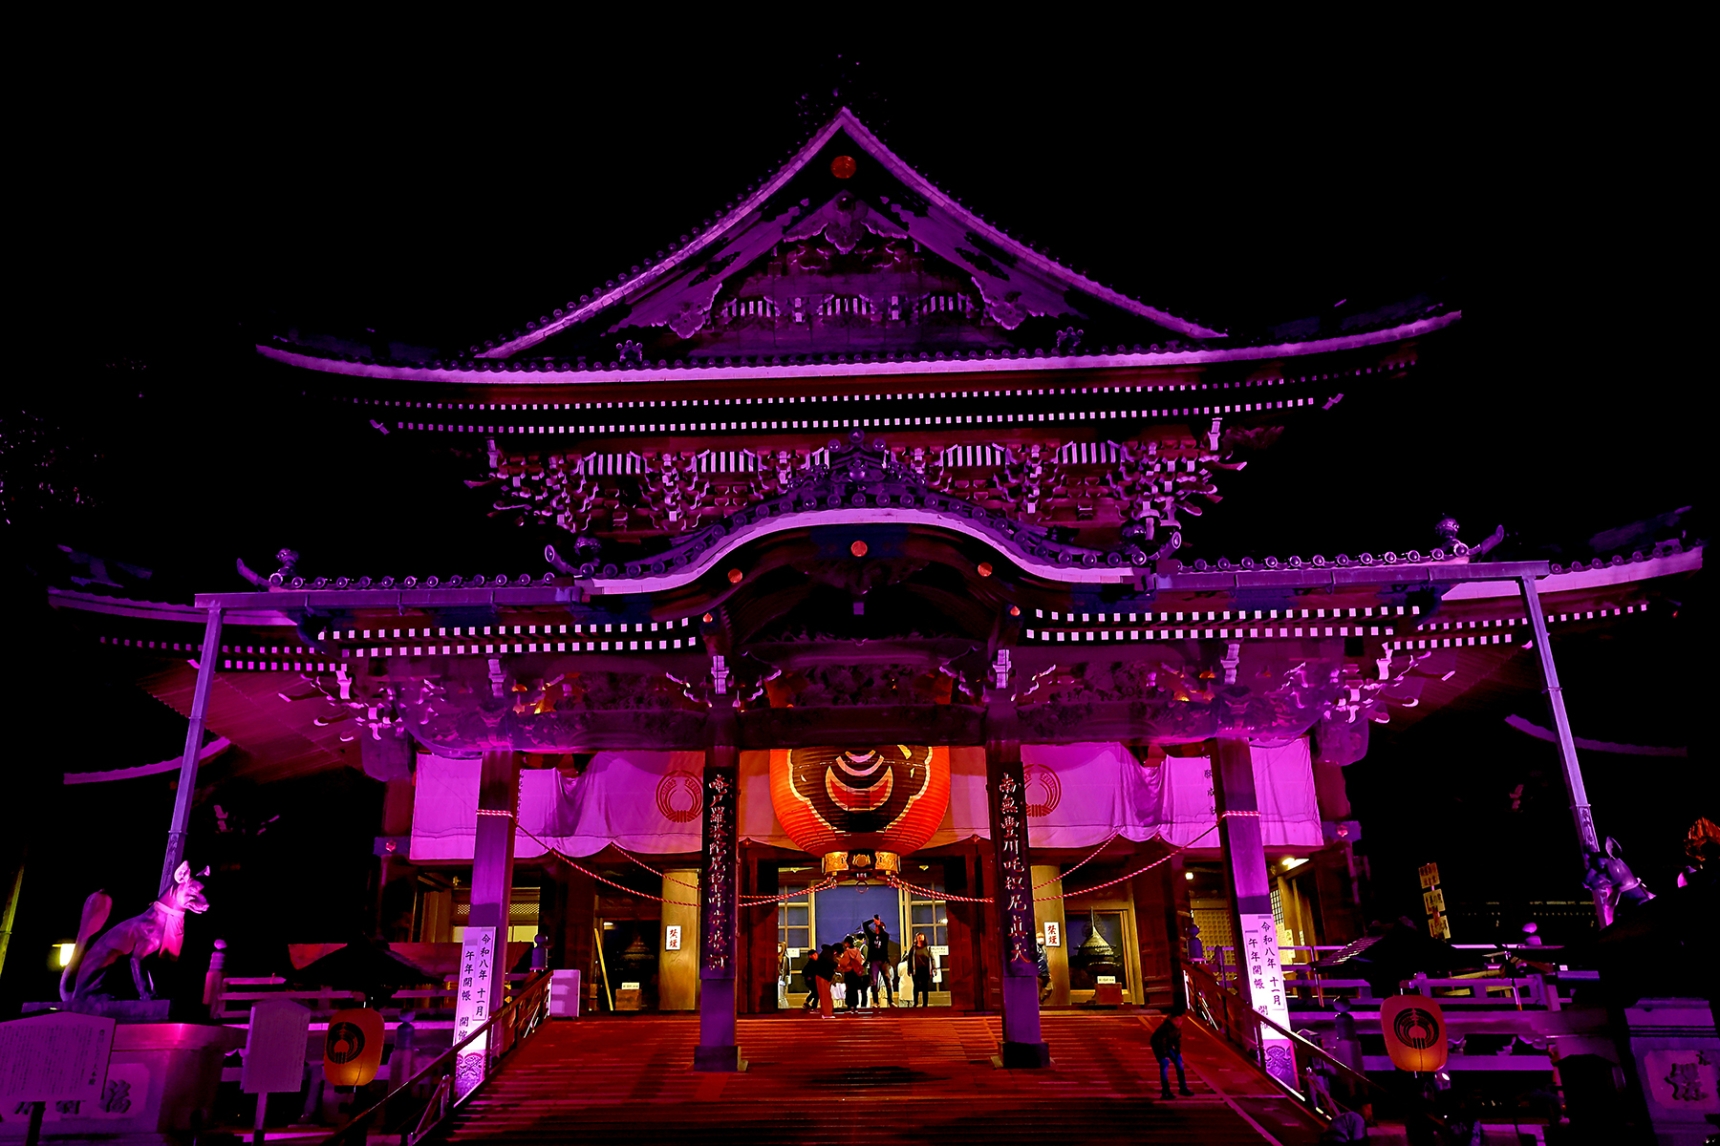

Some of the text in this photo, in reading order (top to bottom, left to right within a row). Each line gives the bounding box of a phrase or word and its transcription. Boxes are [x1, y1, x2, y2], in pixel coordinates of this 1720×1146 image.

[461, 951, 475, 1001] 午年開帳
[475, 934, 491, 1016] 令和八年 十一月
[1248, 938, 1265, 989] 午年開帳
[1261, 921, 1281, 1005] 令和八年 十一月
